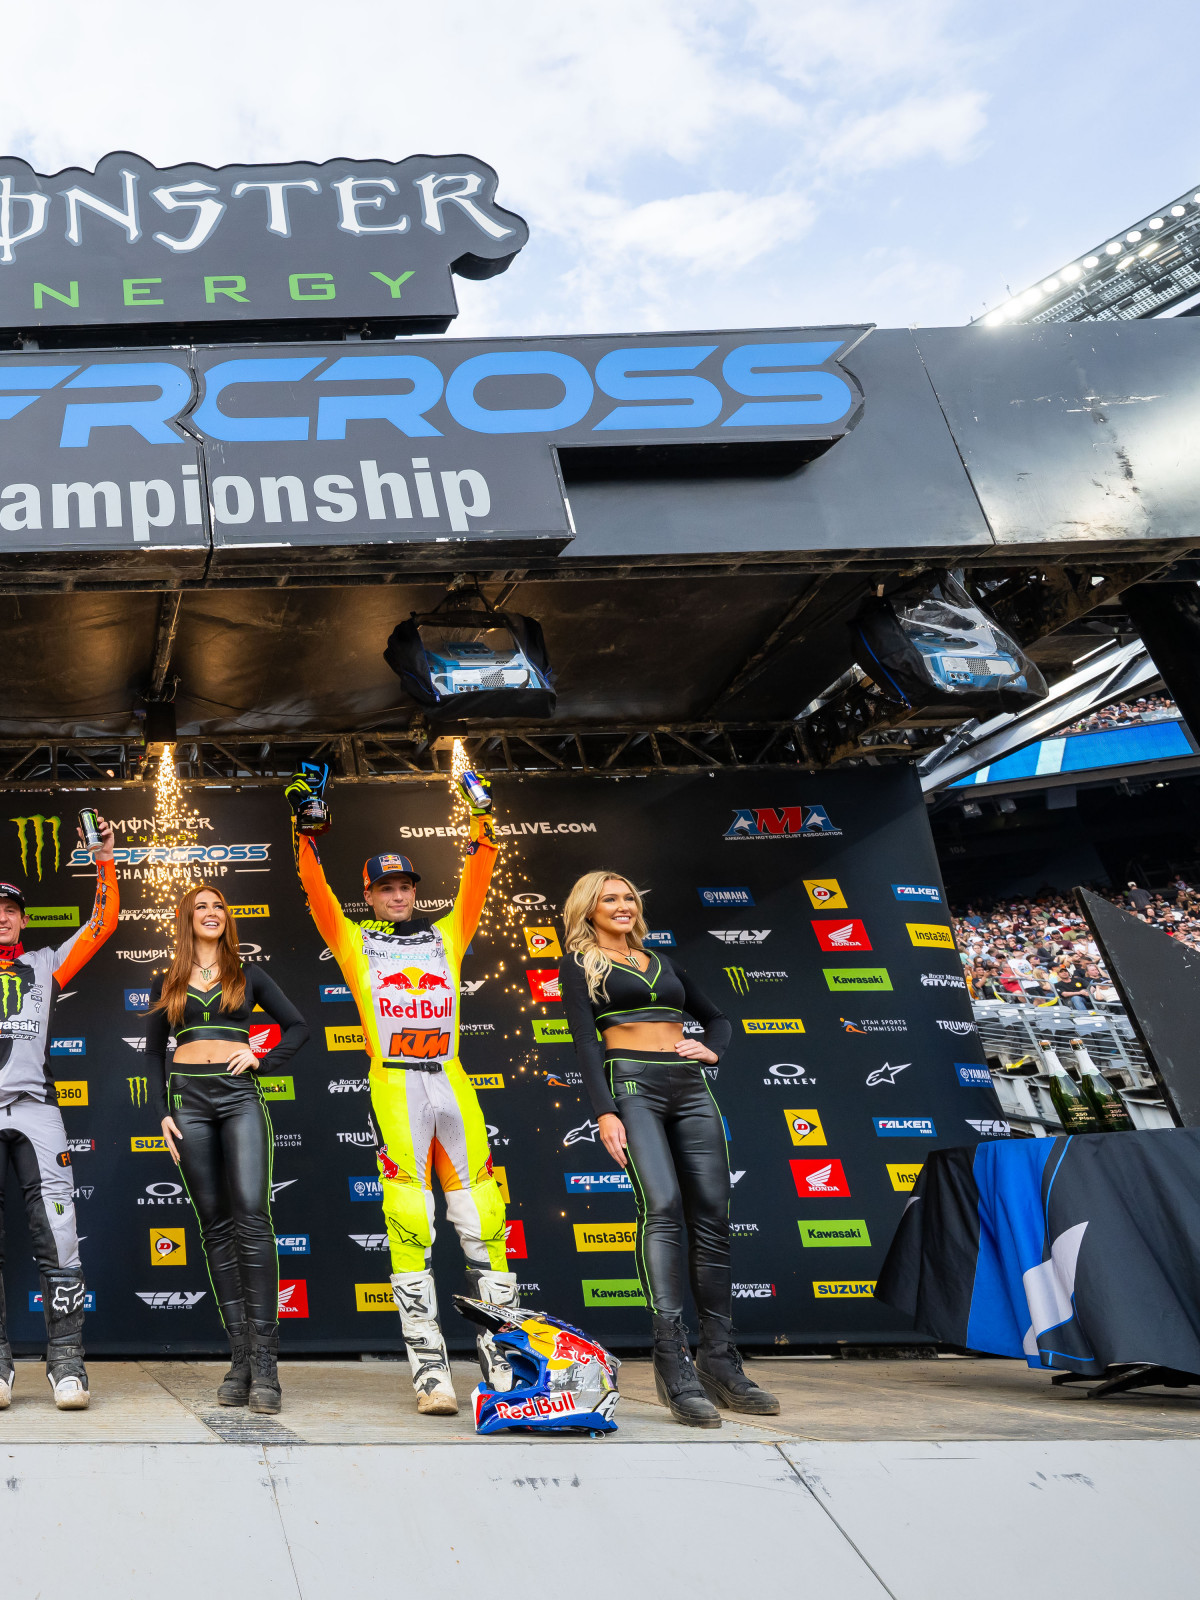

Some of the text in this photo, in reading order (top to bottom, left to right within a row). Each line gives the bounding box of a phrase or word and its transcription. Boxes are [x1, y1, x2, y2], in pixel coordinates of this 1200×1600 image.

[722, 804, 842, 837] AMA
[755, 833, 801, 841] MOTORCYCLIST
[802, 831, 844, 839] ASSOCIATION
[713, 891, 749, 900] YAMAHA
[897, 886, 939, 897] FALKEN
[416, 898, 454, 909] IUMPH
[230, 907, 265, 916] ZUKI
[707, 929, 772, 941] FLY
[915, 930, 951, 943] Insta360
[116, 949, 168, 960] TRIUMPH
[746, 970, 789, 979] MONSTER
[832, 975, 884, 985] Kawasaki
[379, 997, 453, 1019] Red Bull
[541, 1026, 569, 1036] Kawa
[747, 1022, 800, 1031] SUZUKI
[333, 1033, 364, 1044] Insta
[388, 1027, 451, 1059] KTM
[469, 1076, 499, 1086] ZUKI
[878, 1120, 932, 1129] FALKEN
[337, 1132, 375, 1143] TRIUM
[138, 1197, 192, 1205] OAKLEY
[730, 1222, 760, 1232] NSTER
[807, 1228, 862, 1239] Kawasaki
[516, 1283, 541, 1291] STER
[817, 1284, 875, 1294] SUZUKI
[364, 1291, 395, 1303] Insta
[591, 1288, 643, 1298] Kawasak
[135, 1292, 207, 1305] FLY
[495, 1391, 576, 1420] Red Bull
